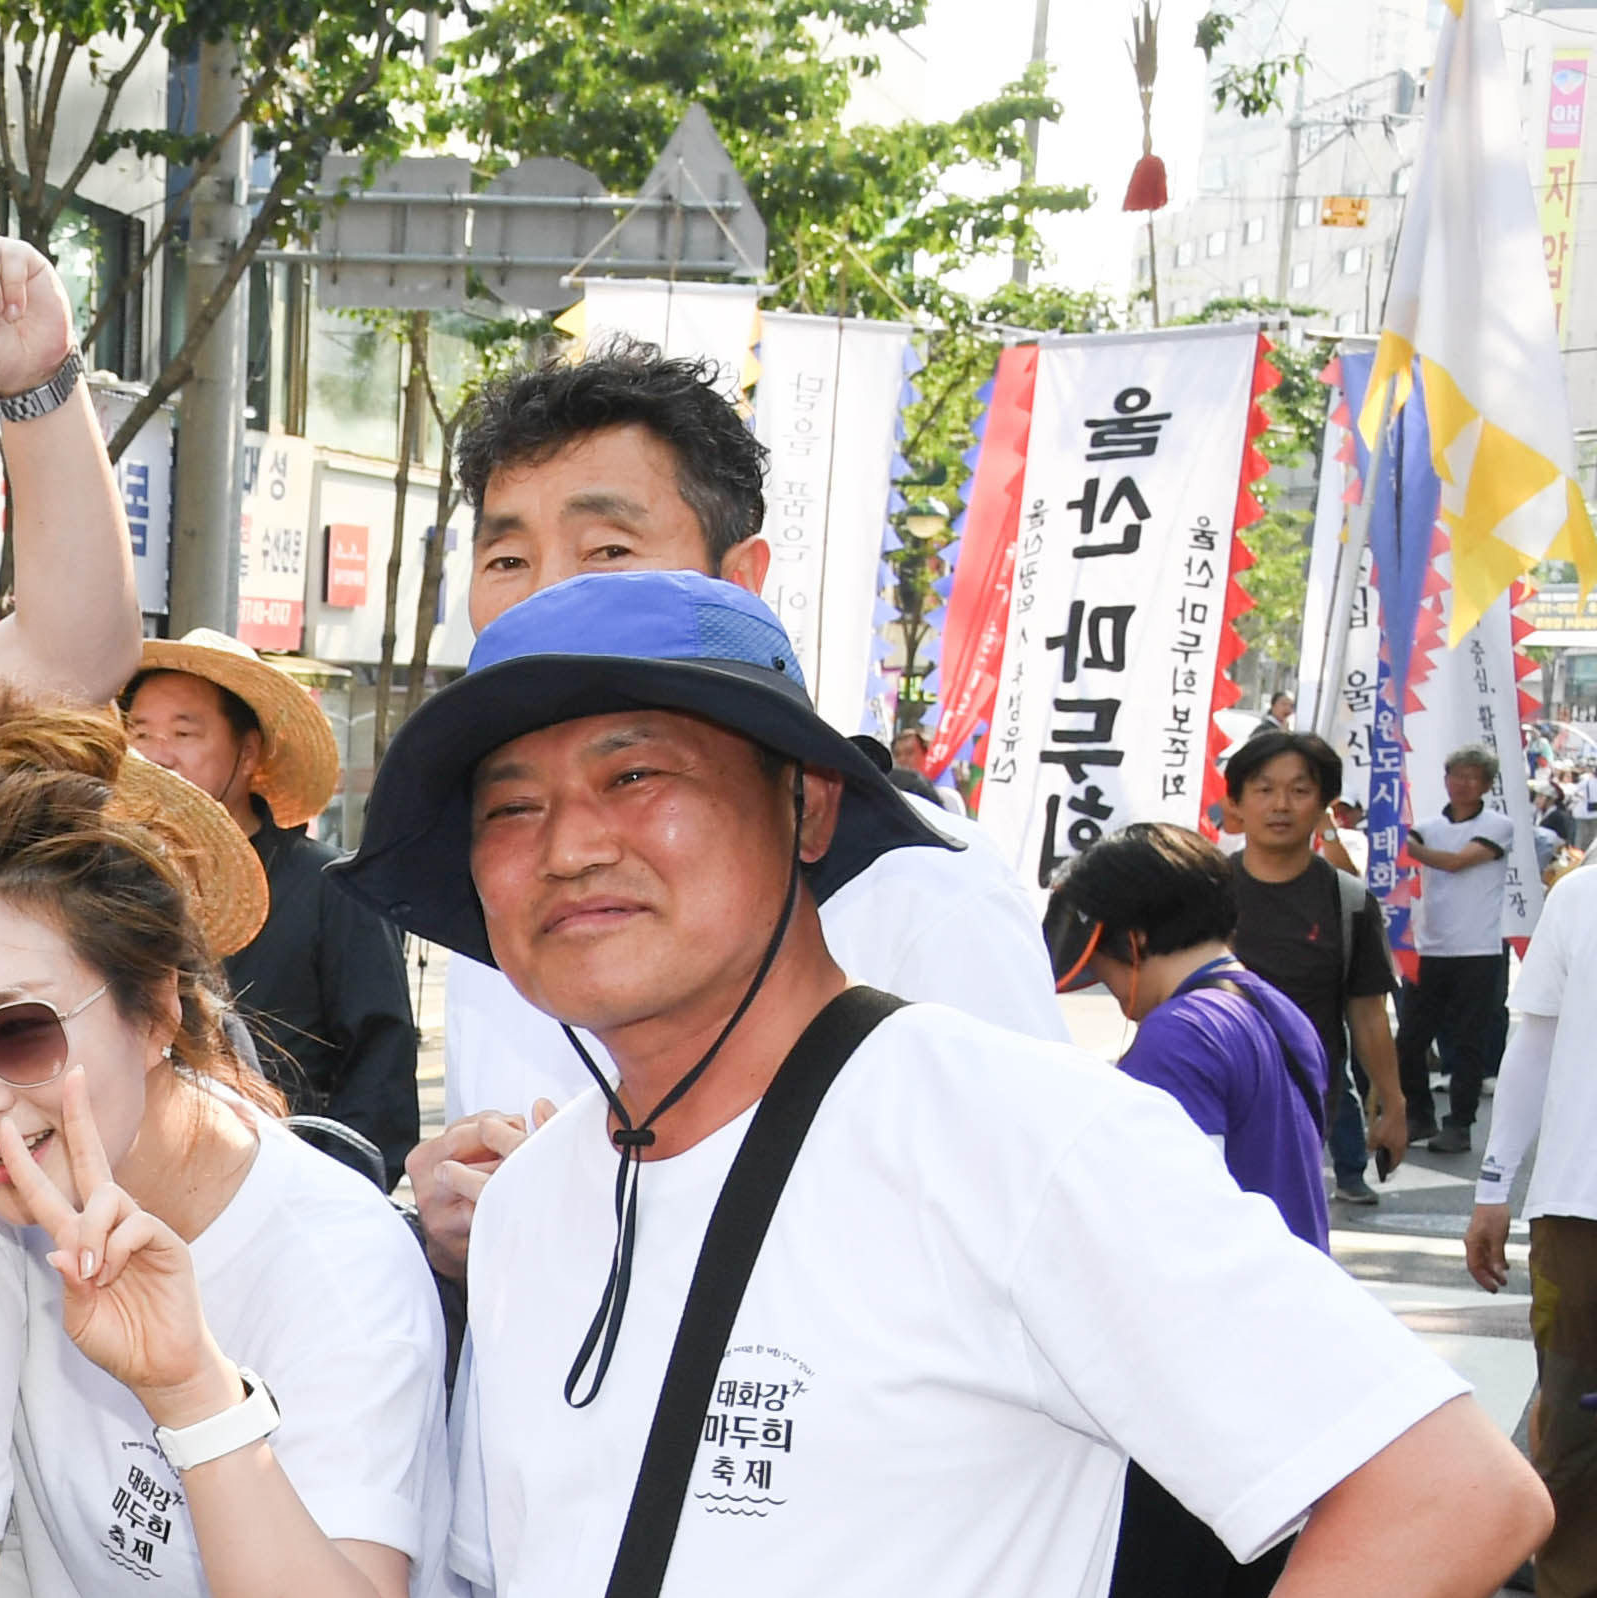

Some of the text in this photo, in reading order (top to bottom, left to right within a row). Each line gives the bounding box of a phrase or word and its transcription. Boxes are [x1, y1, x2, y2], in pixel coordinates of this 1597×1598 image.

[717, 1380, 789, 1411] 태화강
[705, 1414, 793, 1453] 마두희
[128, 1465, 171, 1512] 태화강
[112, 1486, 171, 1544] 마두희
